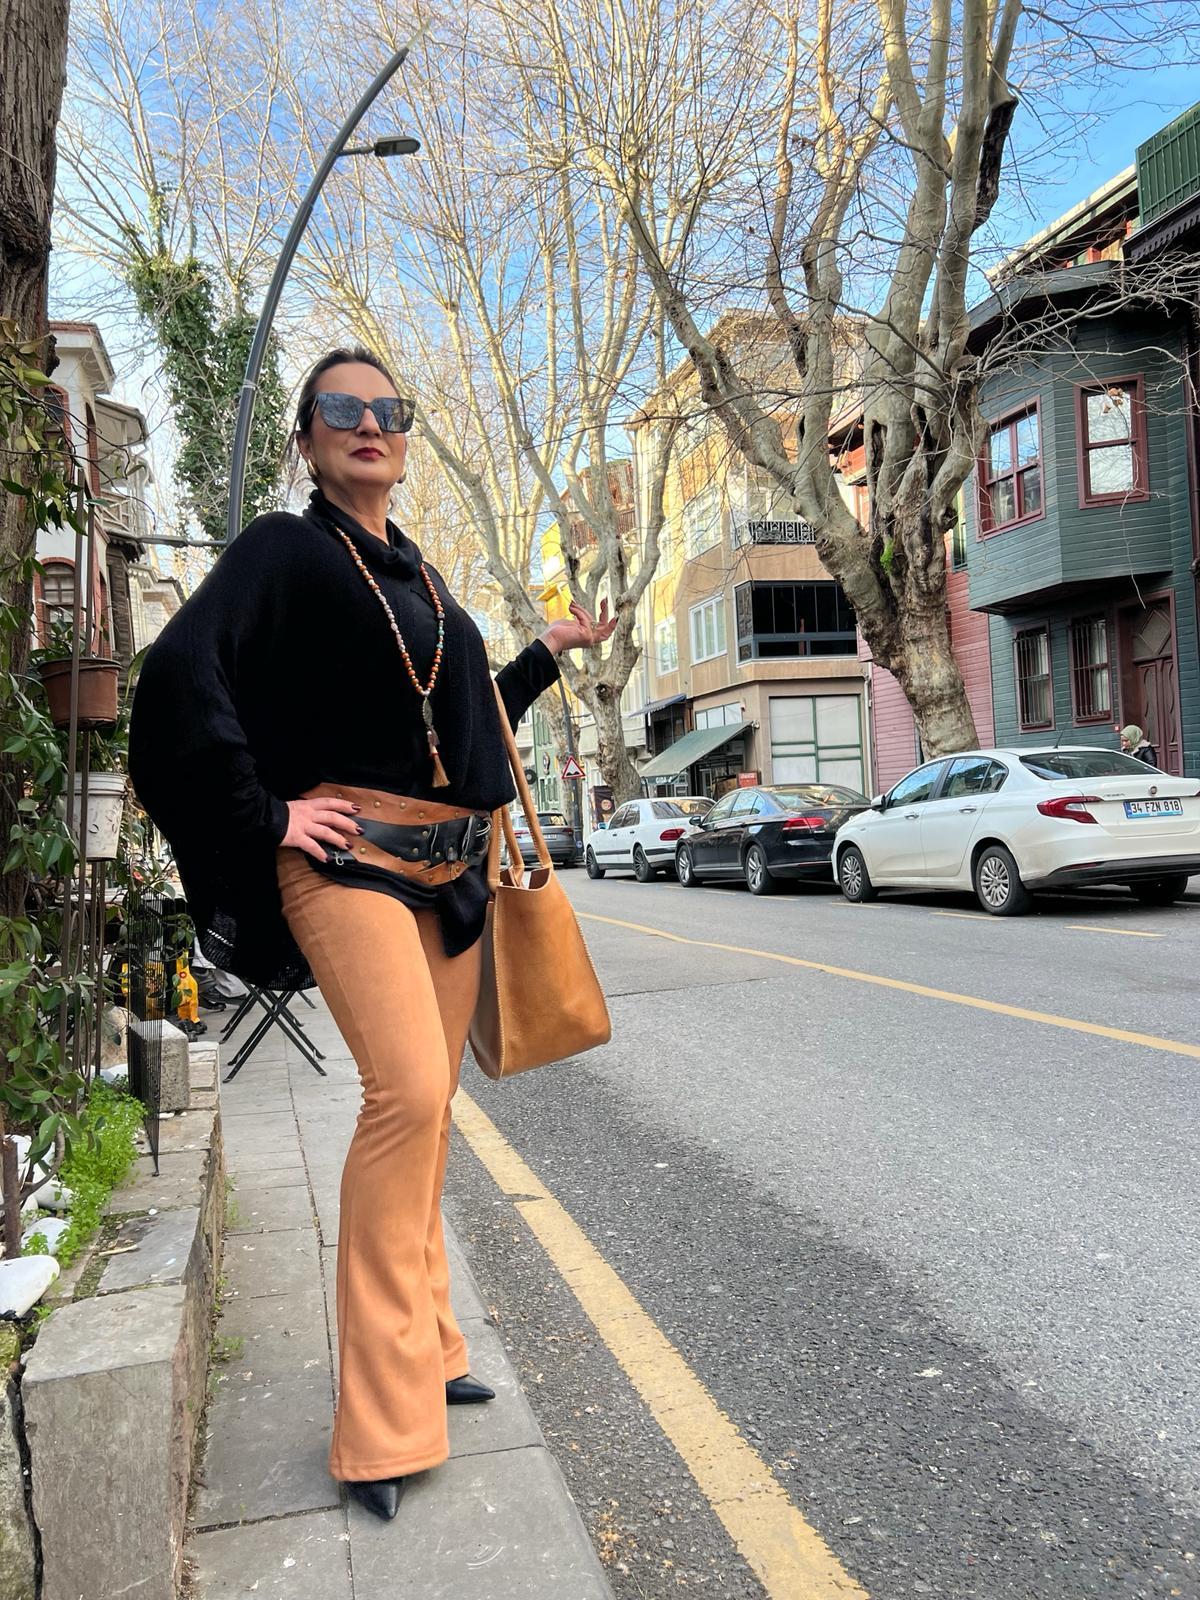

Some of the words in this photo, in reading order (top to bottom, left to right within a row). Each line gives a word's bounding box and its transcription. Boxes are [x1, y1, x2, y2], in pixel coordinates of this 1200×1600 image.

[1131, 803, 1142, 813] 34
[1145, 801, 1161, 812] FZN
[1163, 800, 1180, 811] 818
